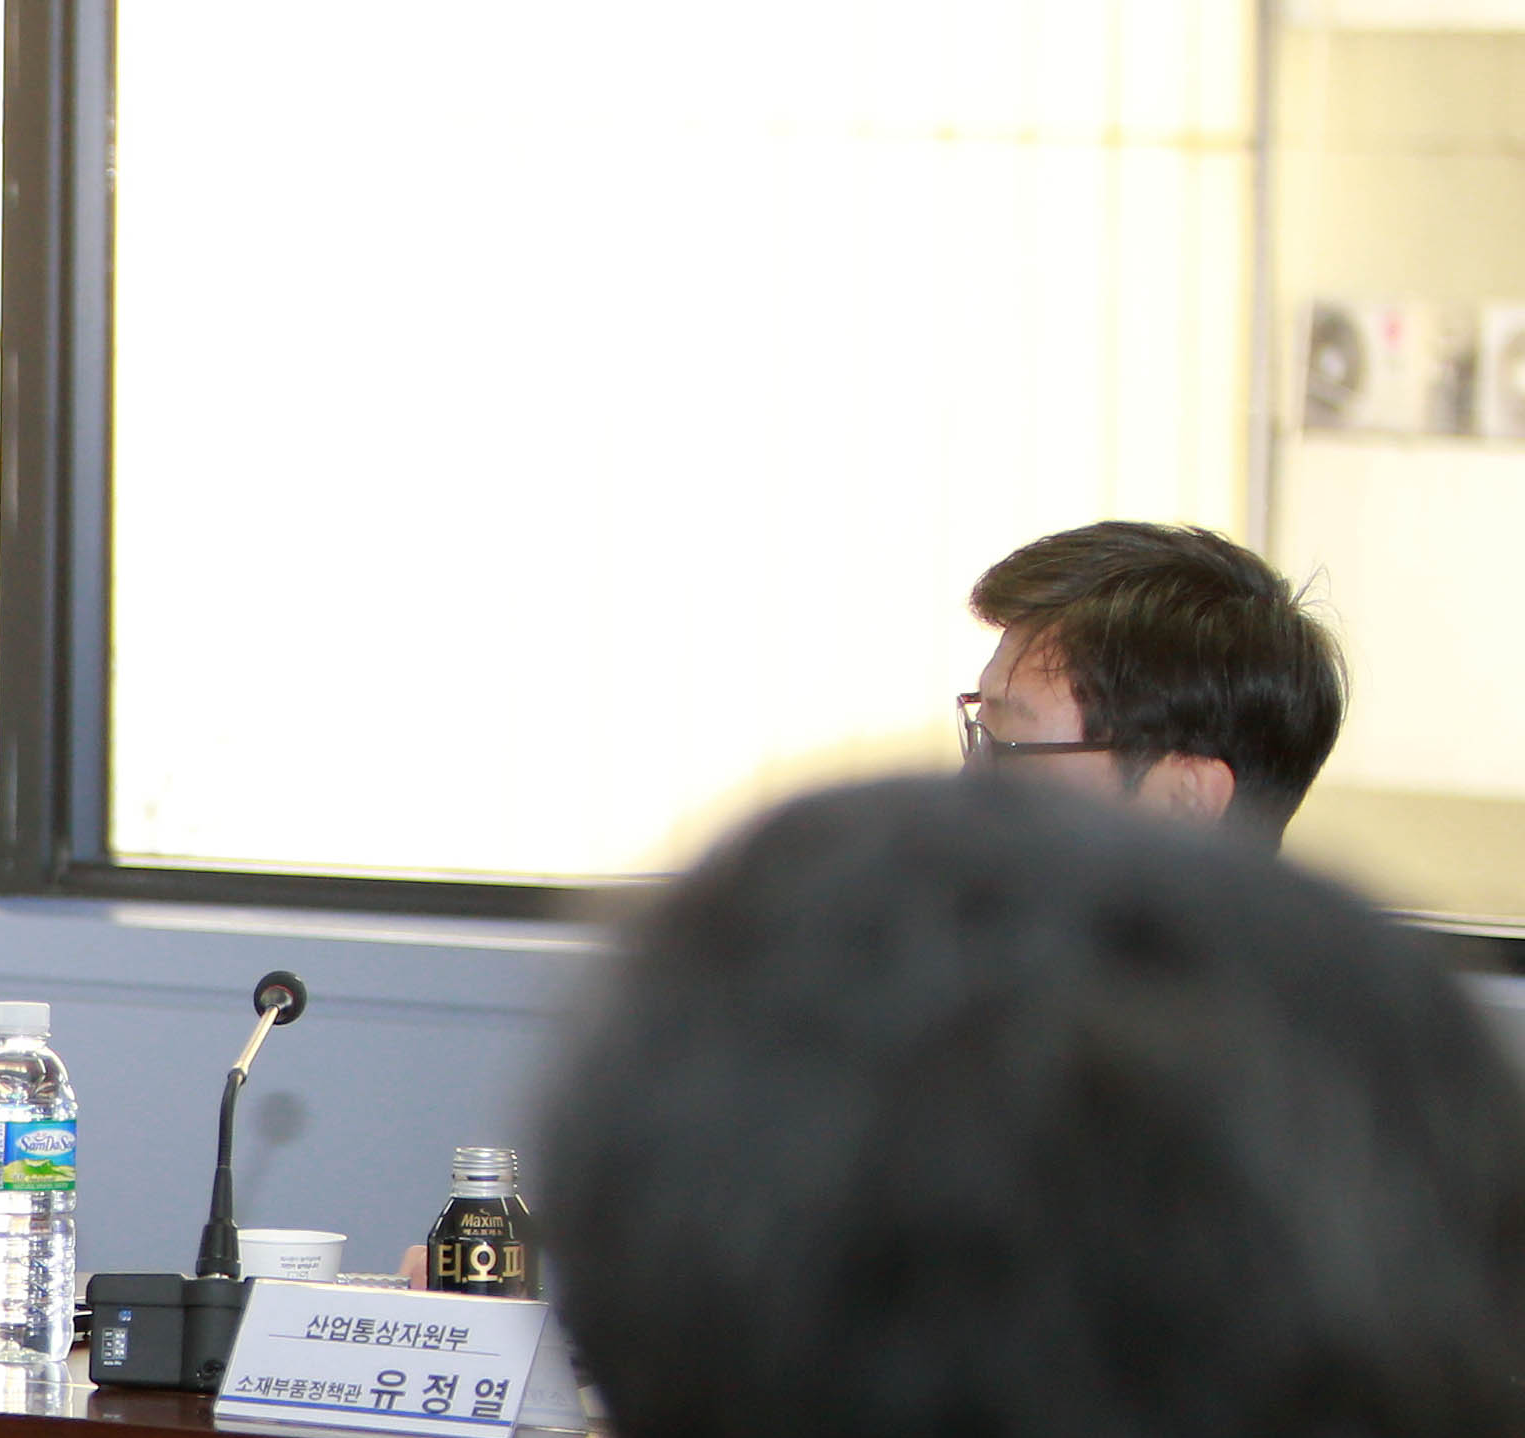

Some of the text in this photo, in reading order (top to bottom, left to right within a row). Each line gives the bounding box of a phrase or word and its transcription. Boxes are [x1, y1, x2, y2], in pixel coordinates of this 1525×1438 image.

[460, 1213, 504, 1228] Maxim
[305, 1314, 470, 1351] 산업통상자원부
[235, 1374, 363, 1404] 소재부품정책관
